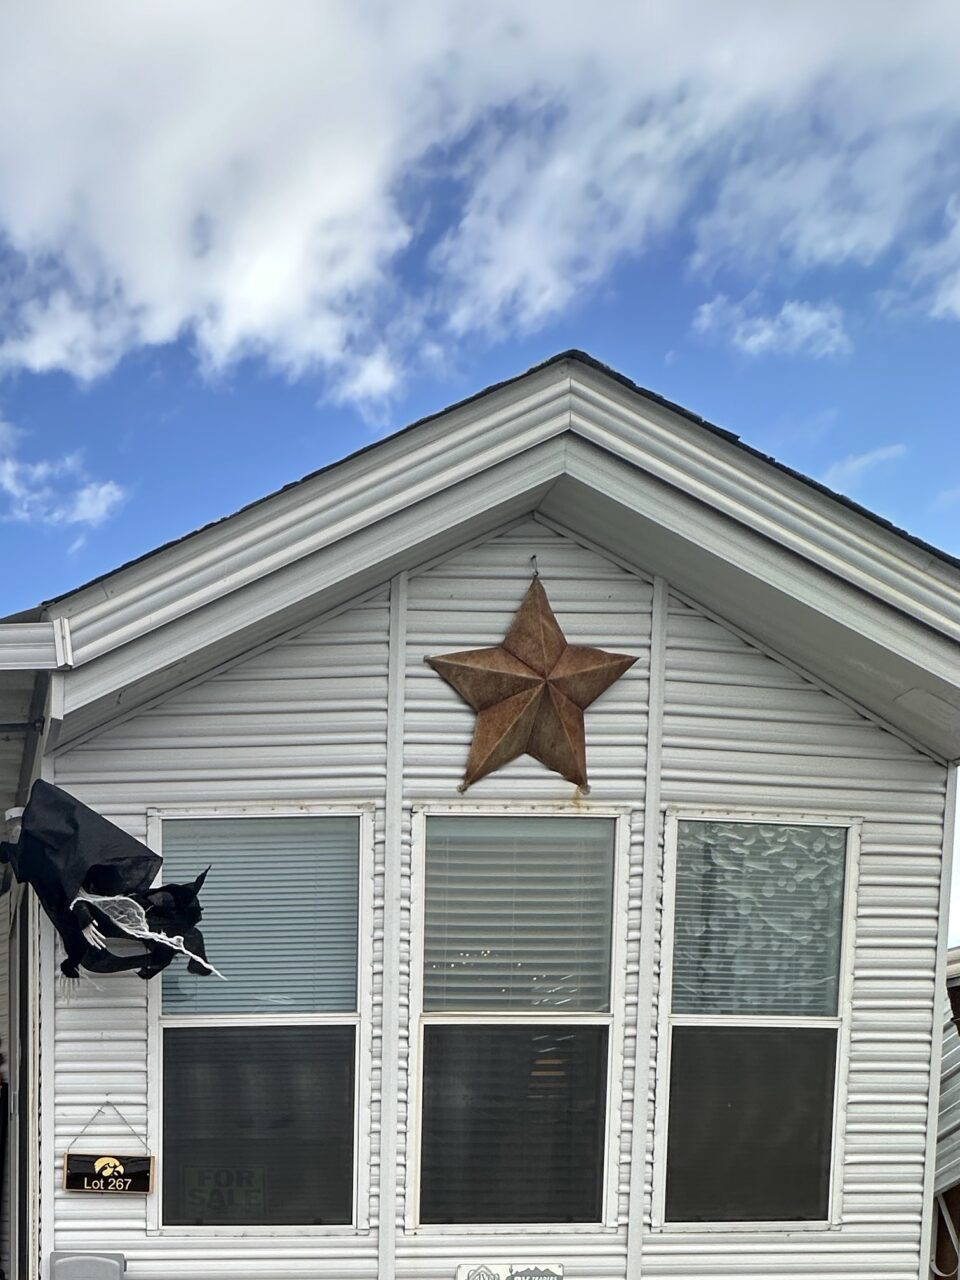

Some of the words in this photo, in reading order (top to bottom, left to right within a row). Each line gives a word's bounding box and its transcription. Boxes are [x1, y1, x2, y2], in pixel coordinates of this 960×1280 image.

[84, 1177, 104, 1190] Lot
[107, 1178, 132, 1191] 267
[197, 1168, 256, 1188] FOR
[188, 1188, 261, 1208] SALE
